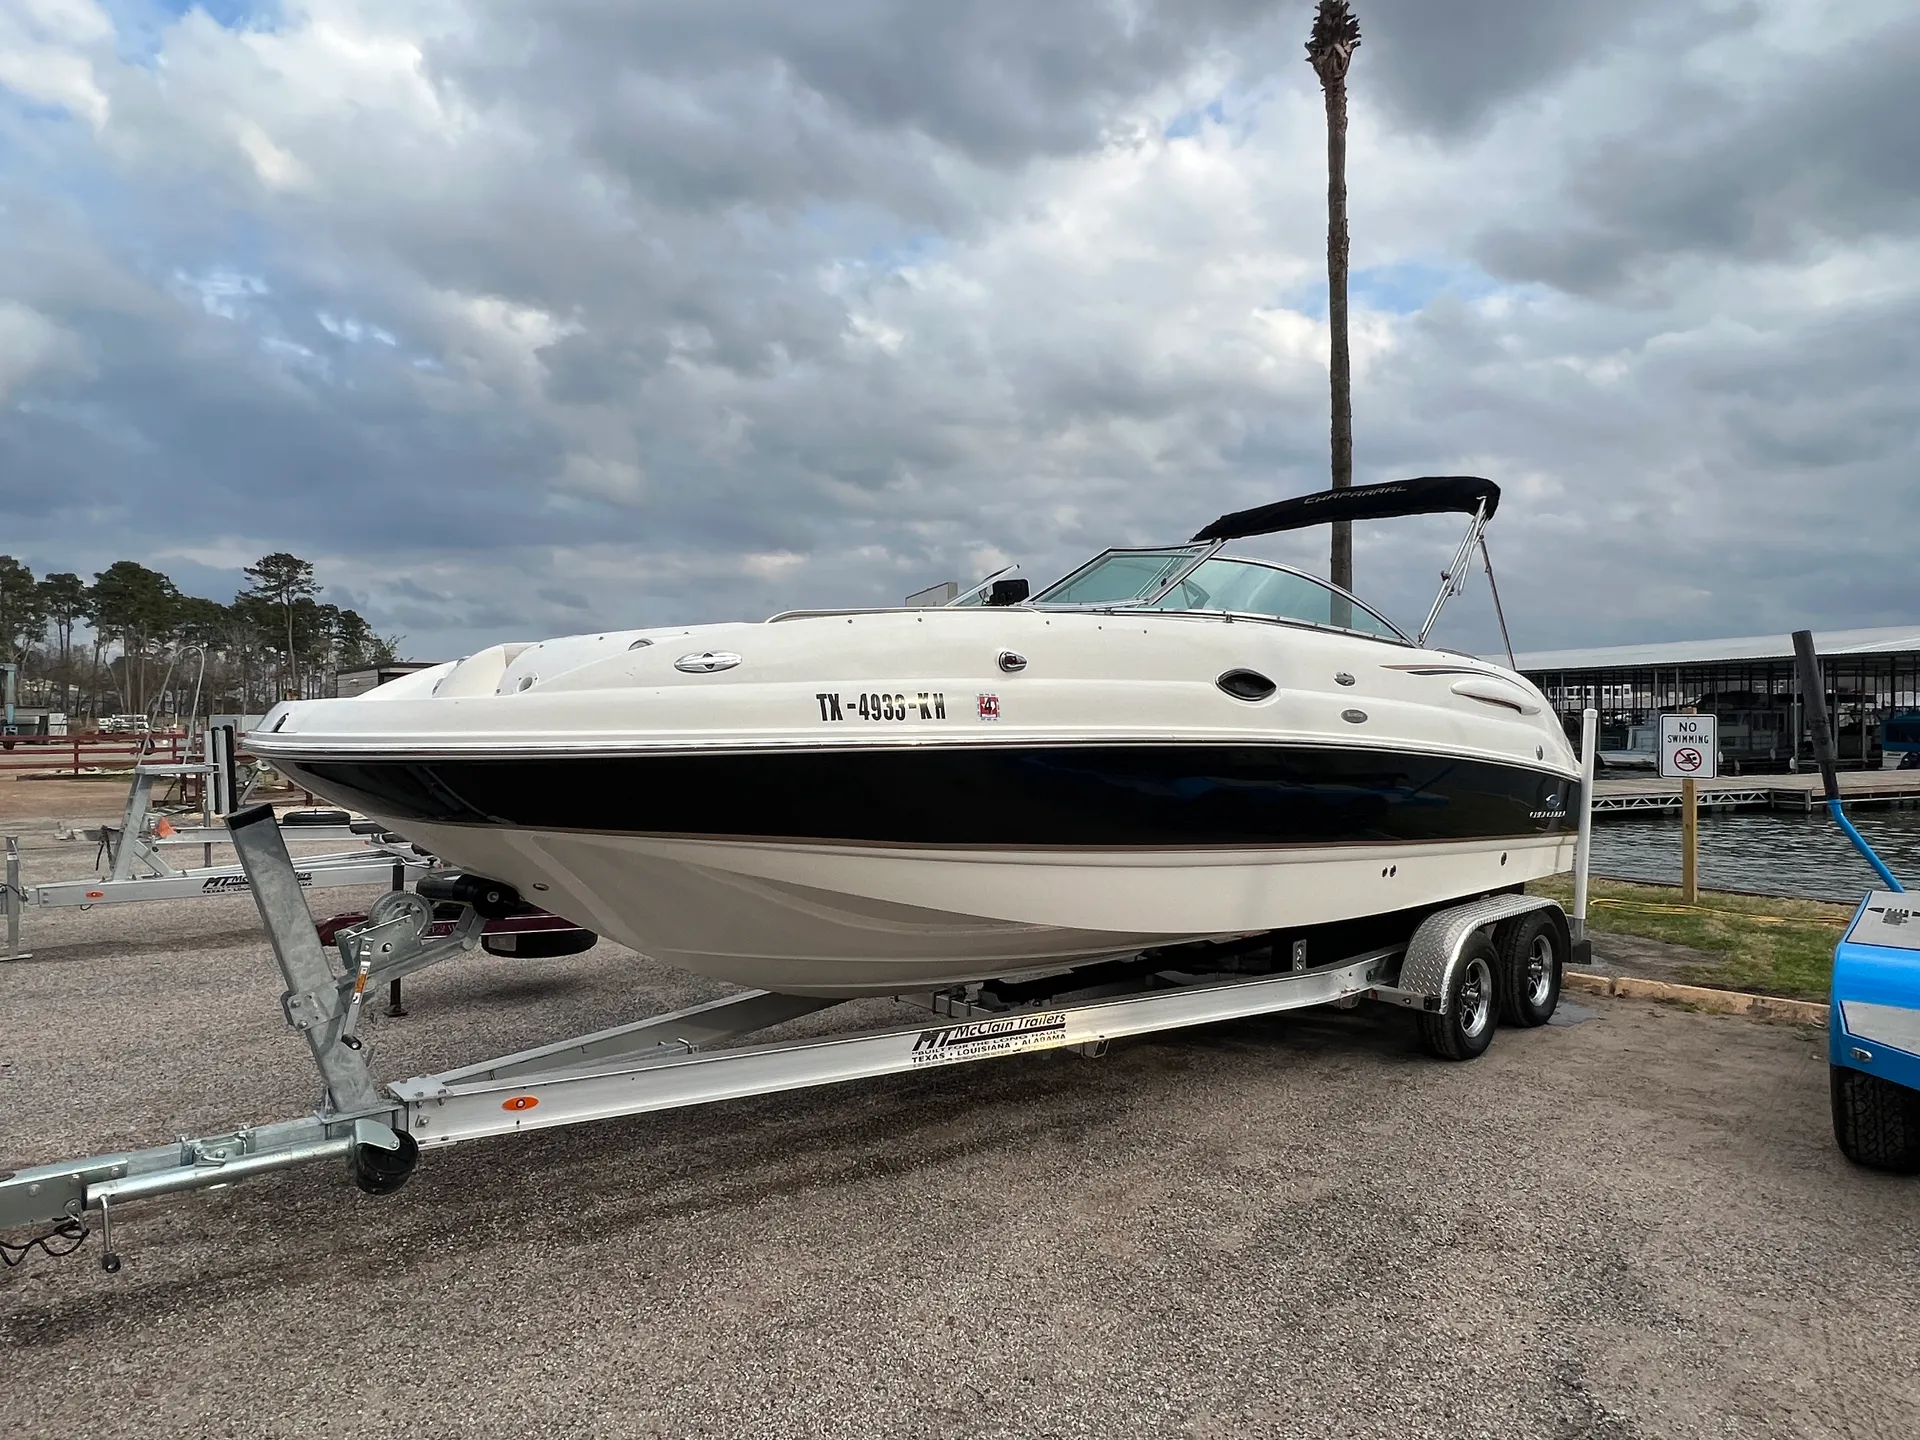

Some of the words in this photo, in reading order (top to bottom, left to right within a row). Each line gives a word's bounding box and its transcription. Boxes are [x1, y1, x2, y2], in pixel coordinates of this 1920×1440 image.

[1679, 721, 1697, 732] NO
[1667, 734, 1709, 743] SWIMMING
[954, 1021, 1013, 1039] McClain
[1018, 1013, 1066, 1029] Trailers
[993, 1035, 1027, 1044] LONG
[912, 1052, 945, 1063] TEXAS
[957, 1042, 1011, 1056] LOUISIANA
[1022, 1033, 1066, 1046] ALABAMA
